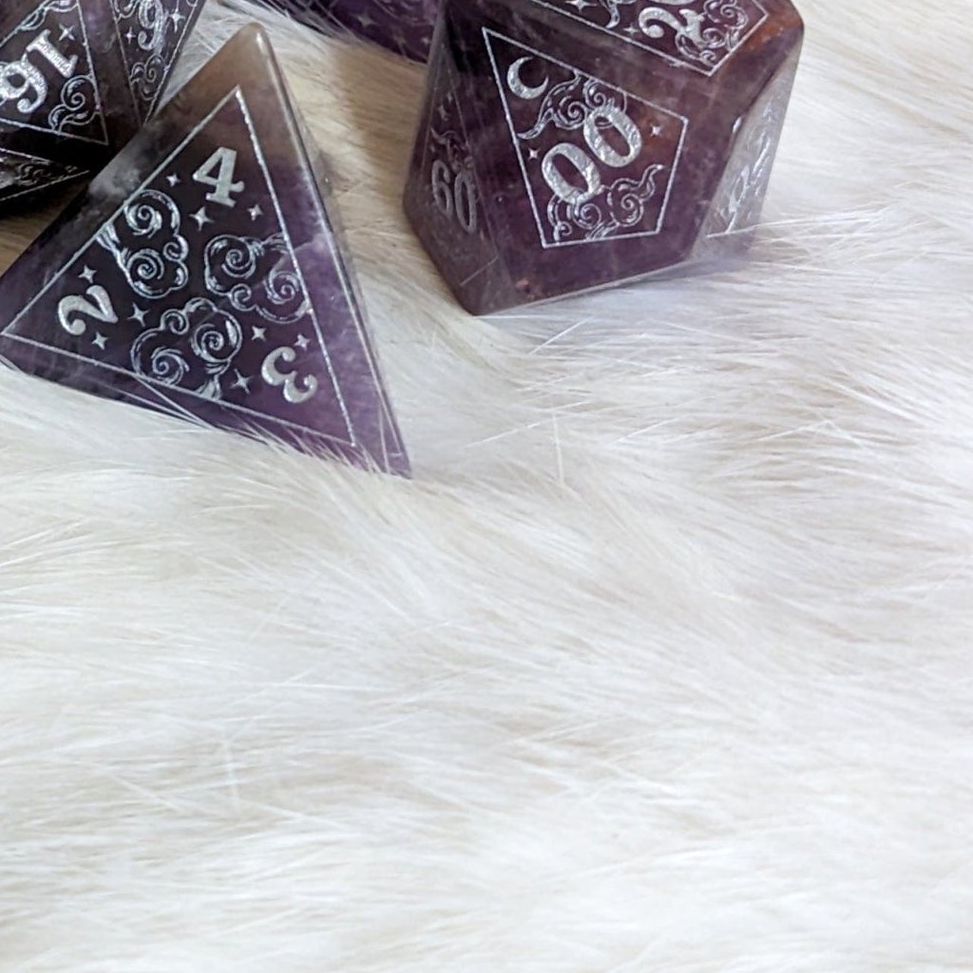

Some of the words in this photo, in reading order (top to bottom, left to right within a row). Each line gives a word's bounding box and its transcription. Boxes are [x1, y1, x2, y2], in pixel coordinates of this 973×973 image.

[192, 146, 245, 209] 4
[542, 105, 643, 205] 00
[431, 159, 478, 234] 60
[57, 284, 119, 336] 2
[260, 346, 318, 404] 3
